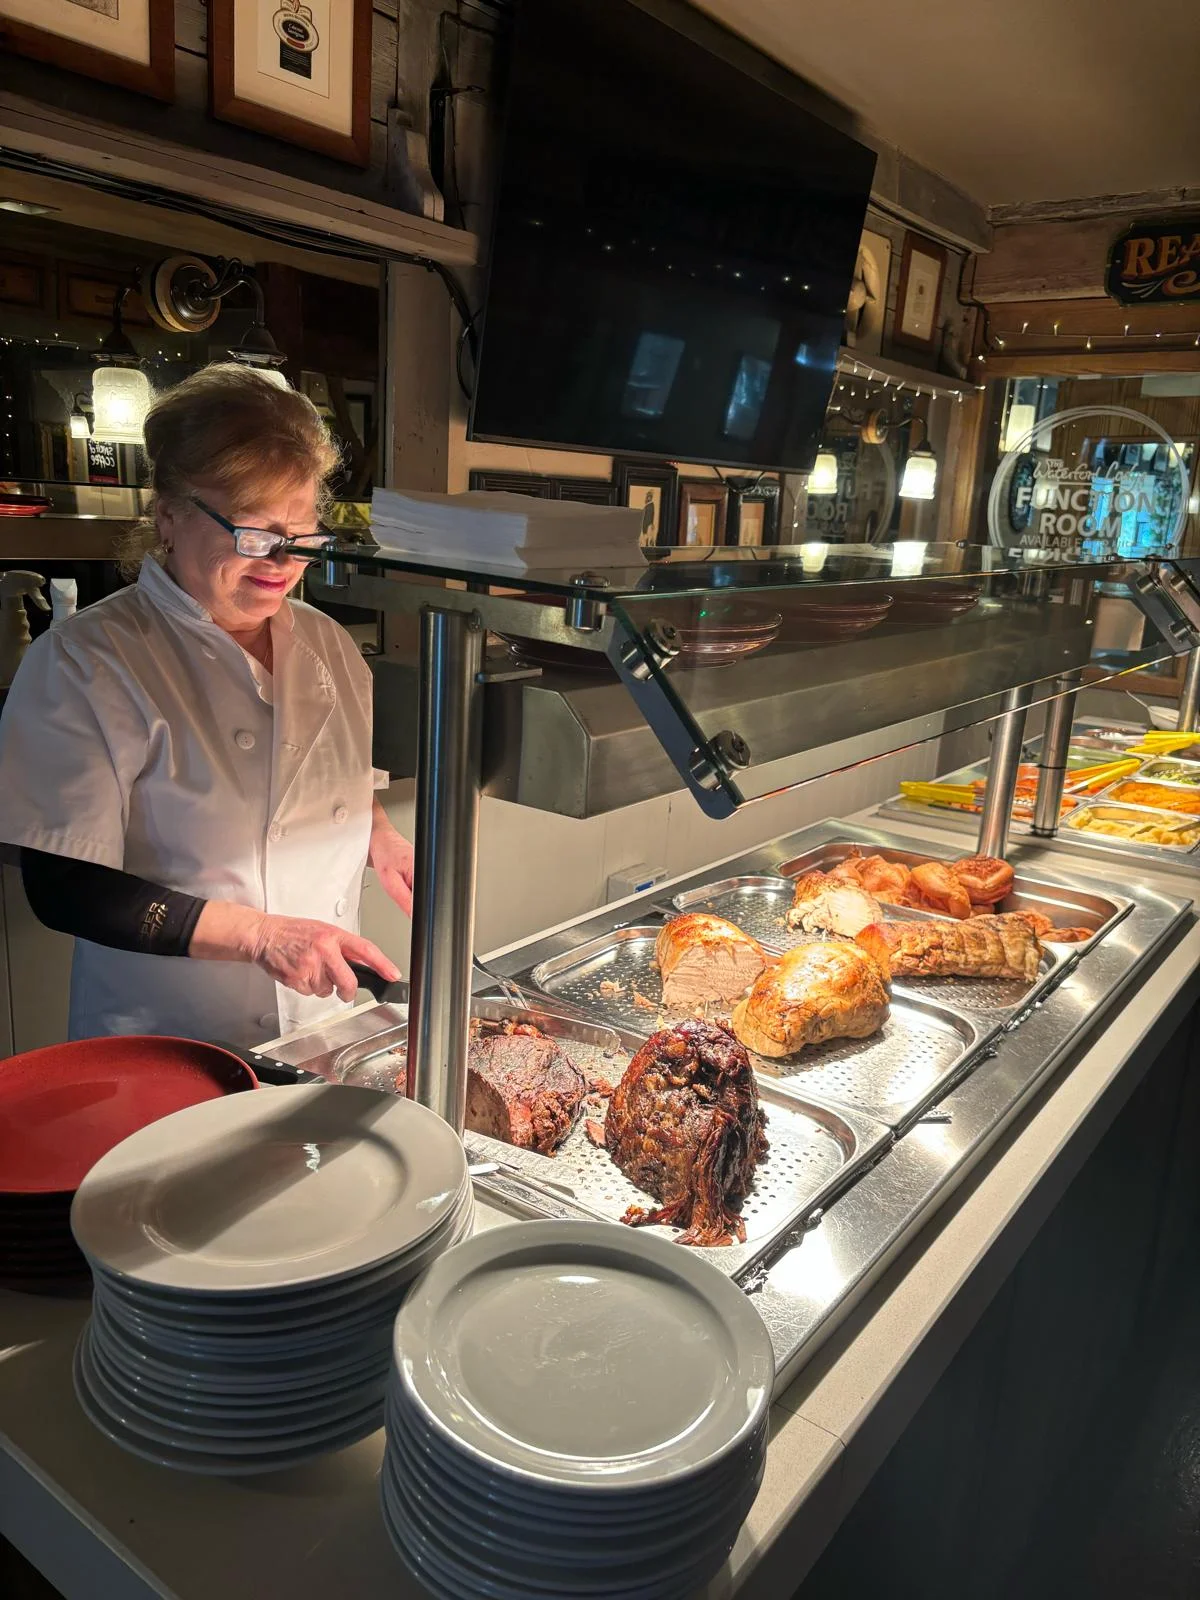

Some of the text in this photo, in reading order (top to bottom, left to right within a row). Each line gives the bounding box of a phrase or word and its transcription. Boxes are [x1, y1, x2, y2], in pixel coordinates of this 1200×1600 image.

[1015, 487, 1155, 514] FUNCTION
[1039, 513, 1123, 538] ROOM
[1019, 534, 1081, 548] AVAILABLE
